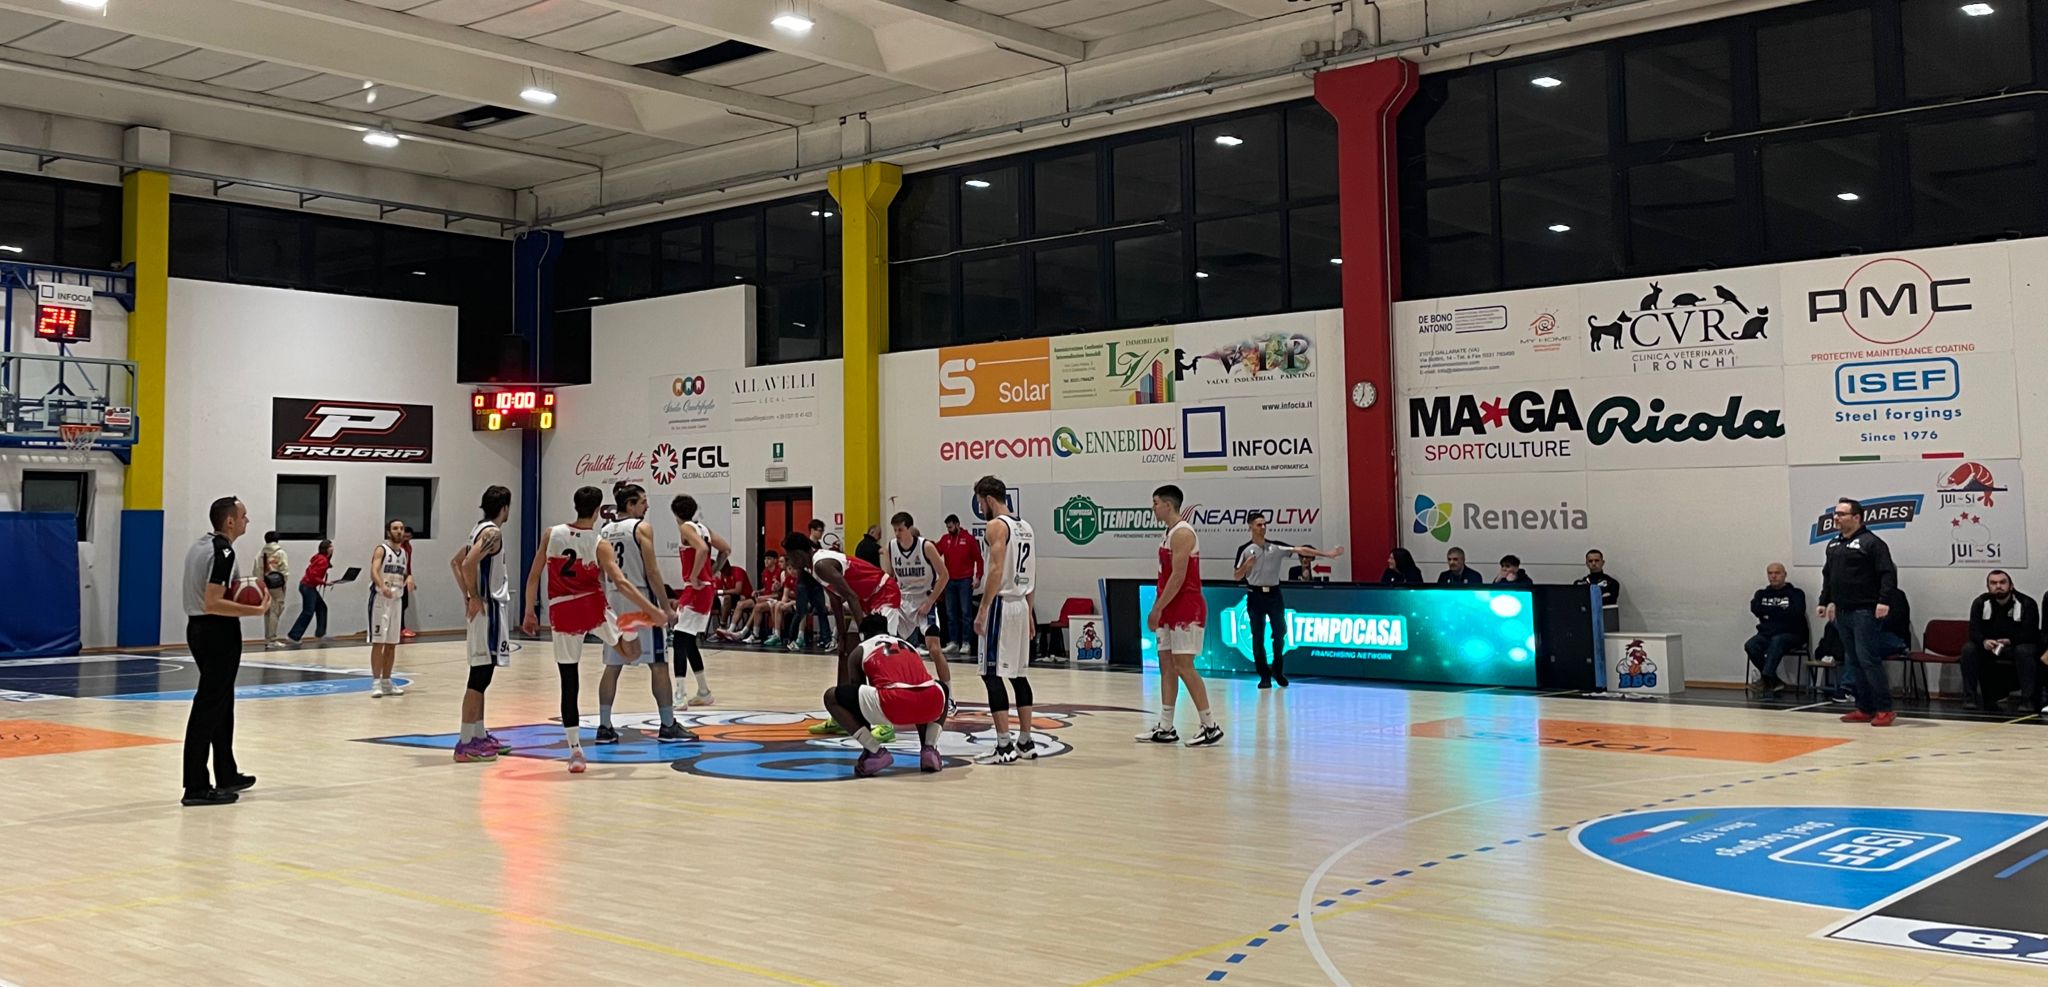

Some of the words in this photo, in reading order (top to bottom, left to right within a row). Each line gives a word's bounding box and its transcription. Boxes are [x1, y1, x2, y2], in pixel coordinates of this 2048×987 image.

[57, 292, 92, 302] INFOCIA
[1808, 278, 1972, 322] PMC
[39, 307, 76, 335] 24
[1418, 315, 1429, 324] DE
[1430, 313, 1453, 323] BONO
[1629, 308, 1731, 347] CVR
[1418, 323, 1453, 334] ANTONIO
[1125, 336, 1169, 346] IMMOBILIARE
[1631, 352, 1670, 362] CLINICA
[1674, 348, 1735, 359] VETERINARIA
[1811, 351, 1863, 361] PROTECTIVE
[1866, 347, 1932, 358] MAINTENANCE
[1935, 343, 1975, 353] COATING
[1653, 356, 1735, 371] RONCHI
[1280, 371, 1316, 380] PAINTING
[1847, 369, 1946, 394] ISEF
[999, 378, 1049, 403] Solar
[496, 391, 535, 409] 10:00
[1261, 401, 1313, 411] www.infocia.it
[488, 413, 501, 430] 0
[540, 412, 552, 429] 0
[1586, 395, 1786, 447] Ricola
[1835, 409, 1877, 422] Steel
[1885, 406, 1962, 422] forgings
[1085, 427, 1176, 454] ENNEBIDOL
[1860, 431, 1896, 442] Since
[1903, 430, 1938, 441] 1976
[283, 446, 426, 458] PROGRIP
[1232, 437, 1313, 457] INFOCIA
[1425, 440, 1571, 461] SPORTCULTURE
[682, 445, 729, 469] FGL
[1142, 453, 1176, 464] LOZIONE
[702, 471, 730, 479] LOGISTICS
[1270, 463, 1309, 471] INFORMATICA
[1276, 507, 1320, 525] LTW
[1463, 501, 1588, 530] Renexia
[560, 548, 577, 577] 2
[1016, 542, 1030, 573] 12
[1949, 543, 1972, 565] JUI
[1295, 616, 1403, 647] TEMPOCASA
[1311, 650, 1355, 659] FRANCHISING
[1357, 652, 1393, 661] NETWORK
[1817, 831, 1925, 866] ISEF
